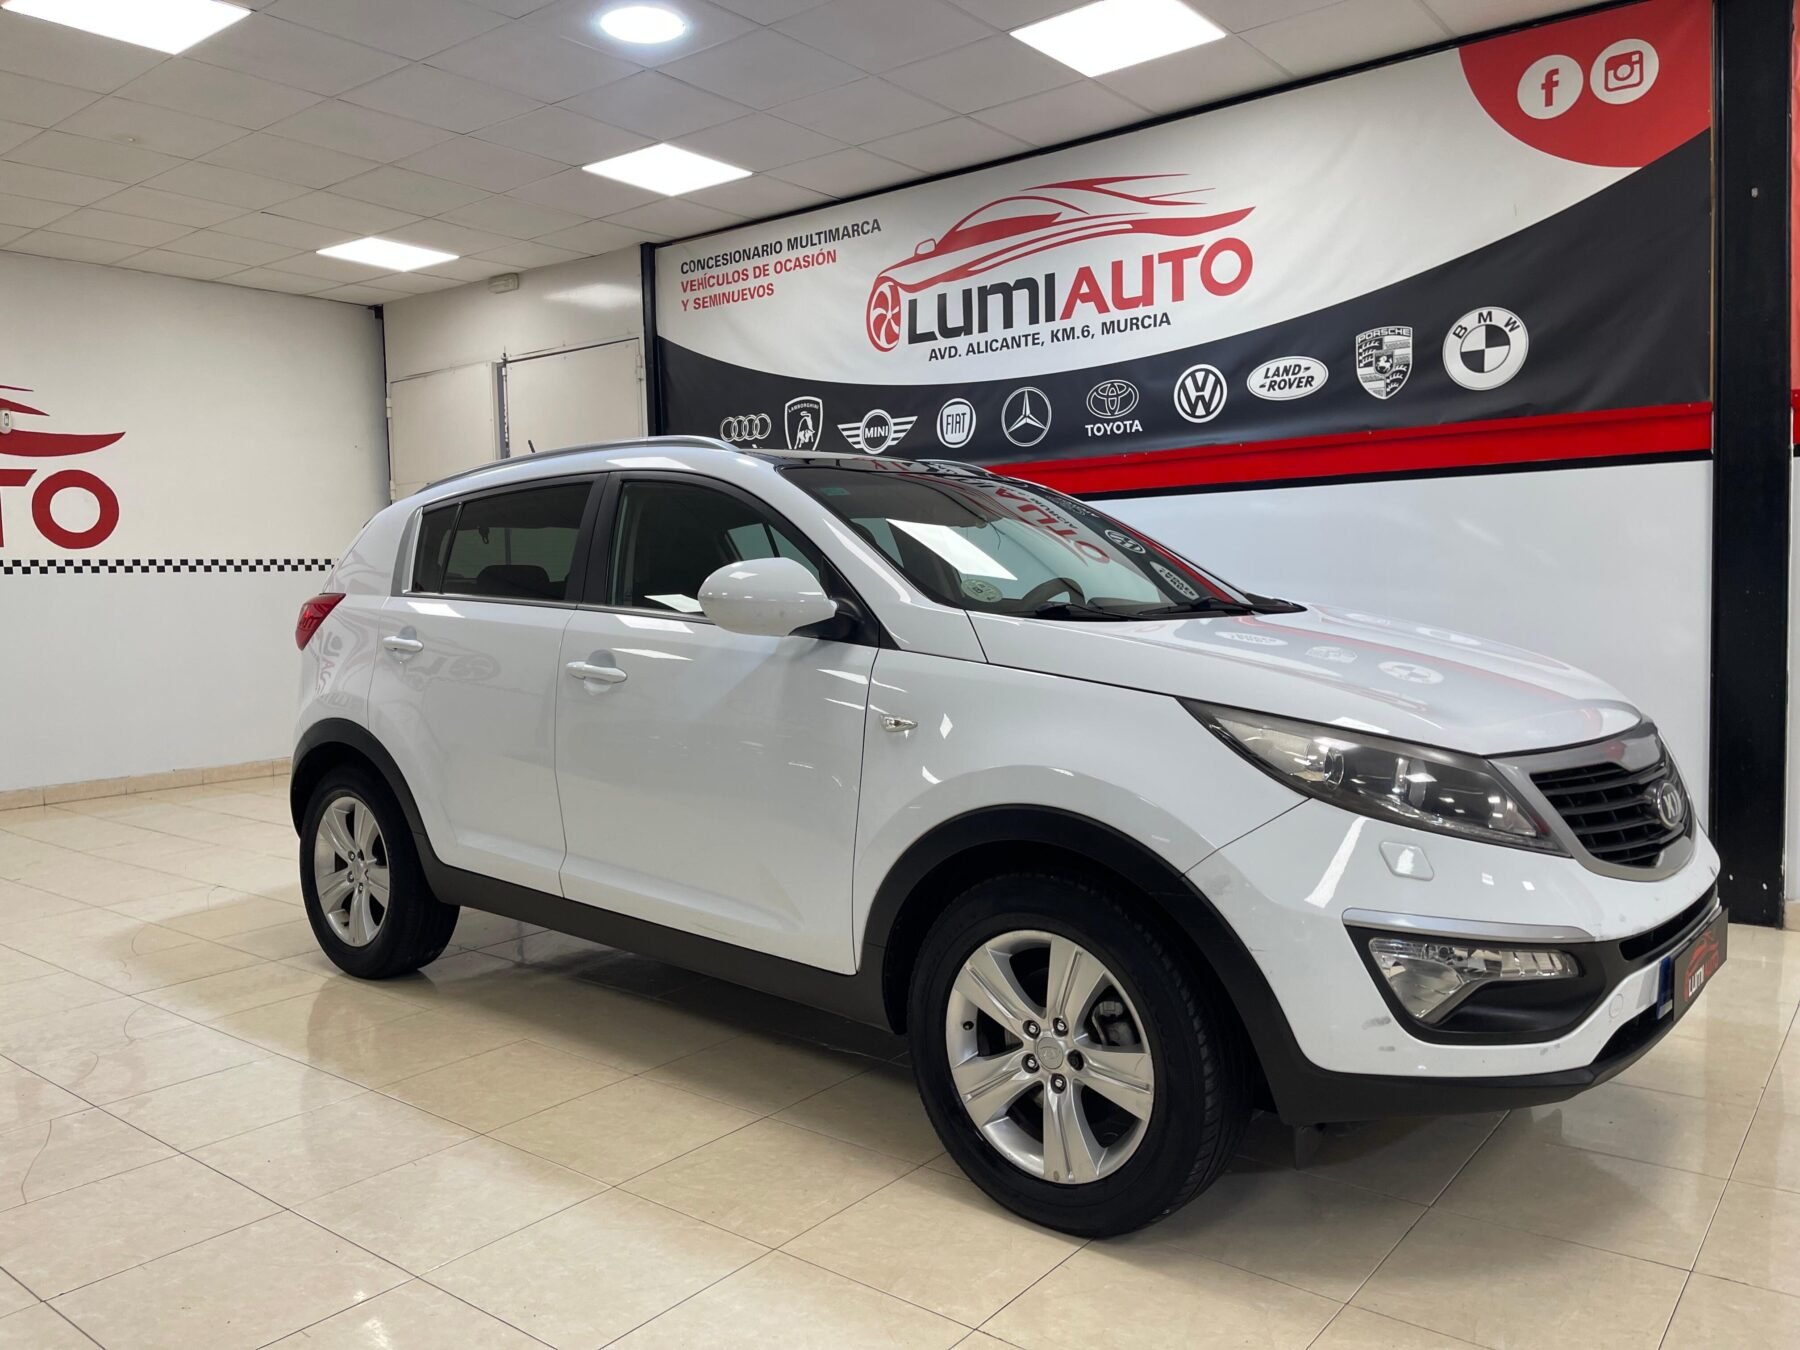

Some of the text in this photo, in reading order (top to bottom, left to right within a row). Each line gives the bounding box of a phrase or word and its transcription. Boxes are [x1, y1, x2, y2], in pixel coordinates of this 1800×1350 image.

[680, 218, 882, 275] CONCESIONARIO MULTIMARCA
[680, 247, 837, 294] VEHÍCULOS DE OCASIÓN
[680, 282, 775, 312] Y SEMINUEVOS
[928, 311, 1172, 362] AVD. ALICANTE, KM.6, MURCIA
[1358, 327, 1411, 344] PORSCHE
[1452, 310, 1521, 340] BMW
[787, 402, 820, 413] LAMBORGHINI
[864, 424, 889, 440] MINI
[945, 411, 968, 436] FIAT
[1084, 419, 1143, 437] TOYOTA
